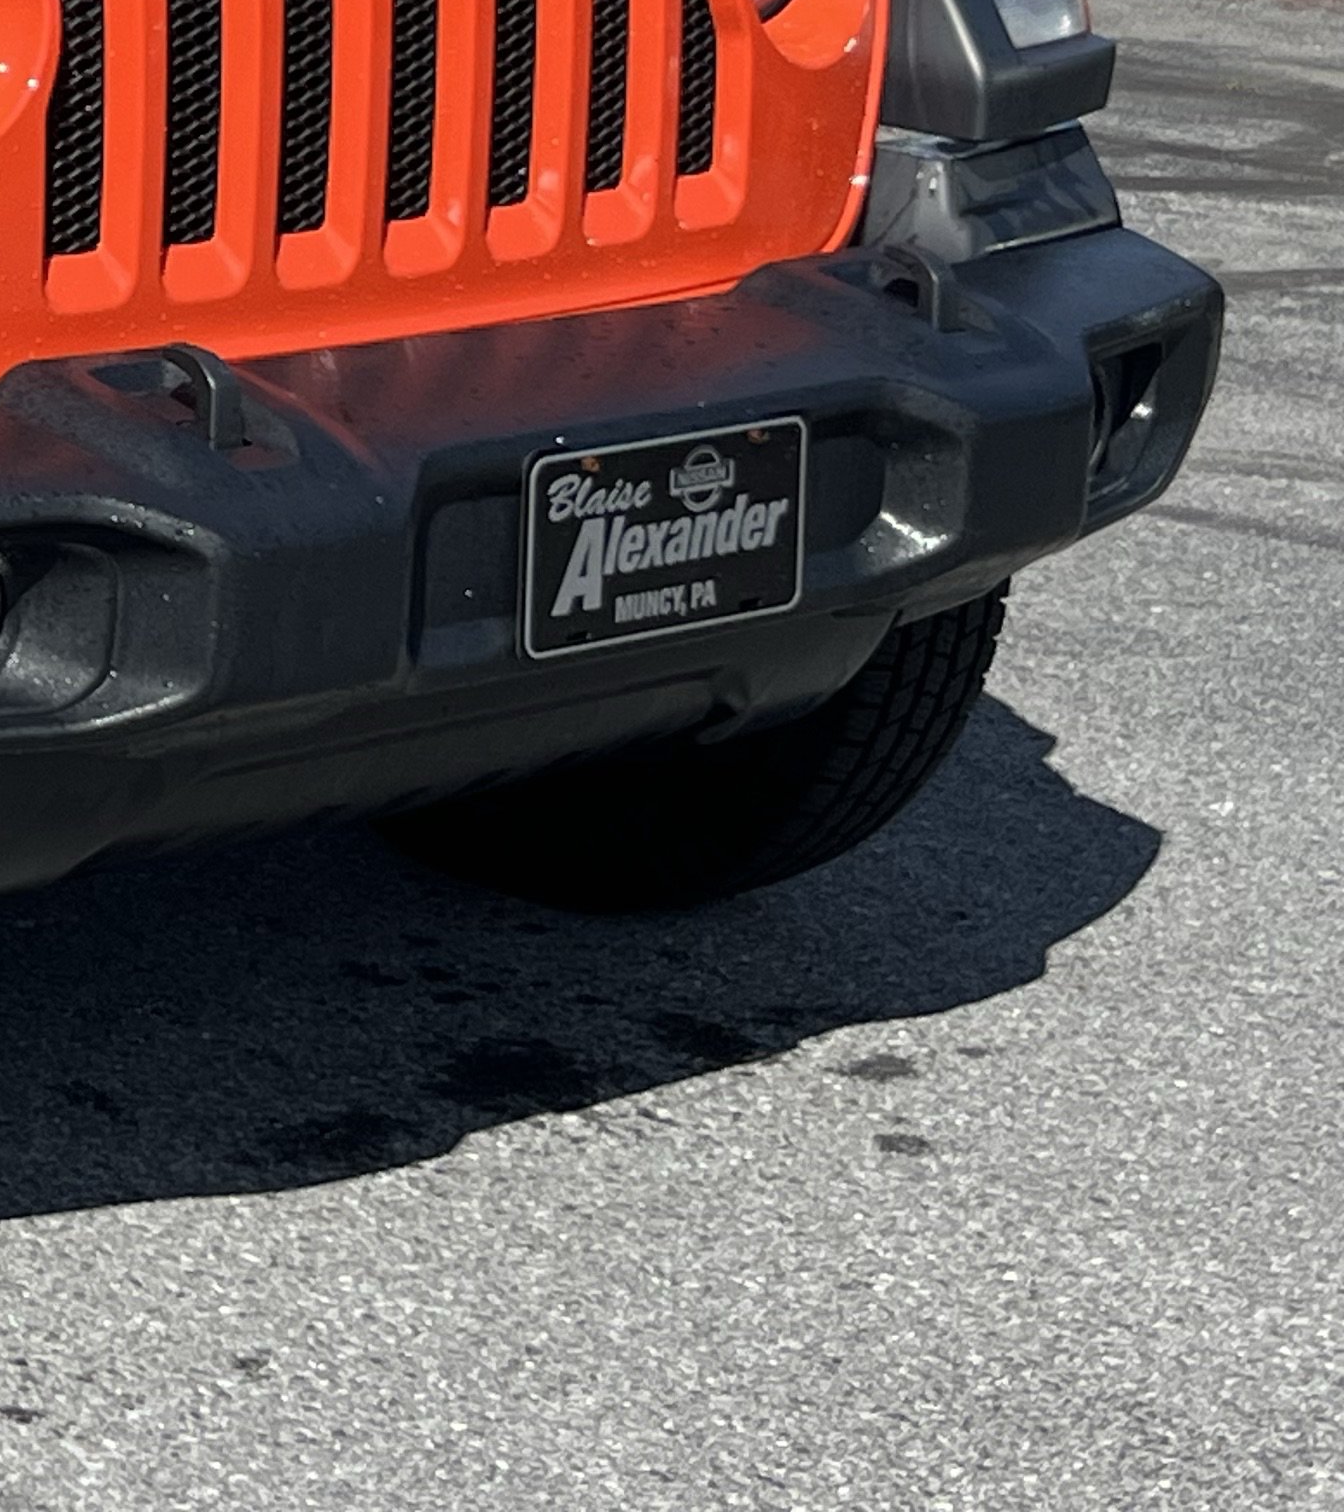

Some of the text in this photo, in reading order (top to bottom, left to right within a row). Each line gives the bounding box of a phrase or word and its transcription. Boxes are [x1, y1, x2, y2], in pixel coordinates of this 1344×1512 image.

[547, 474, 653, 522] Blaise
[550, 493, 789, 618] Alexander
[615, 579, 716, 624] MUNCY, PA
